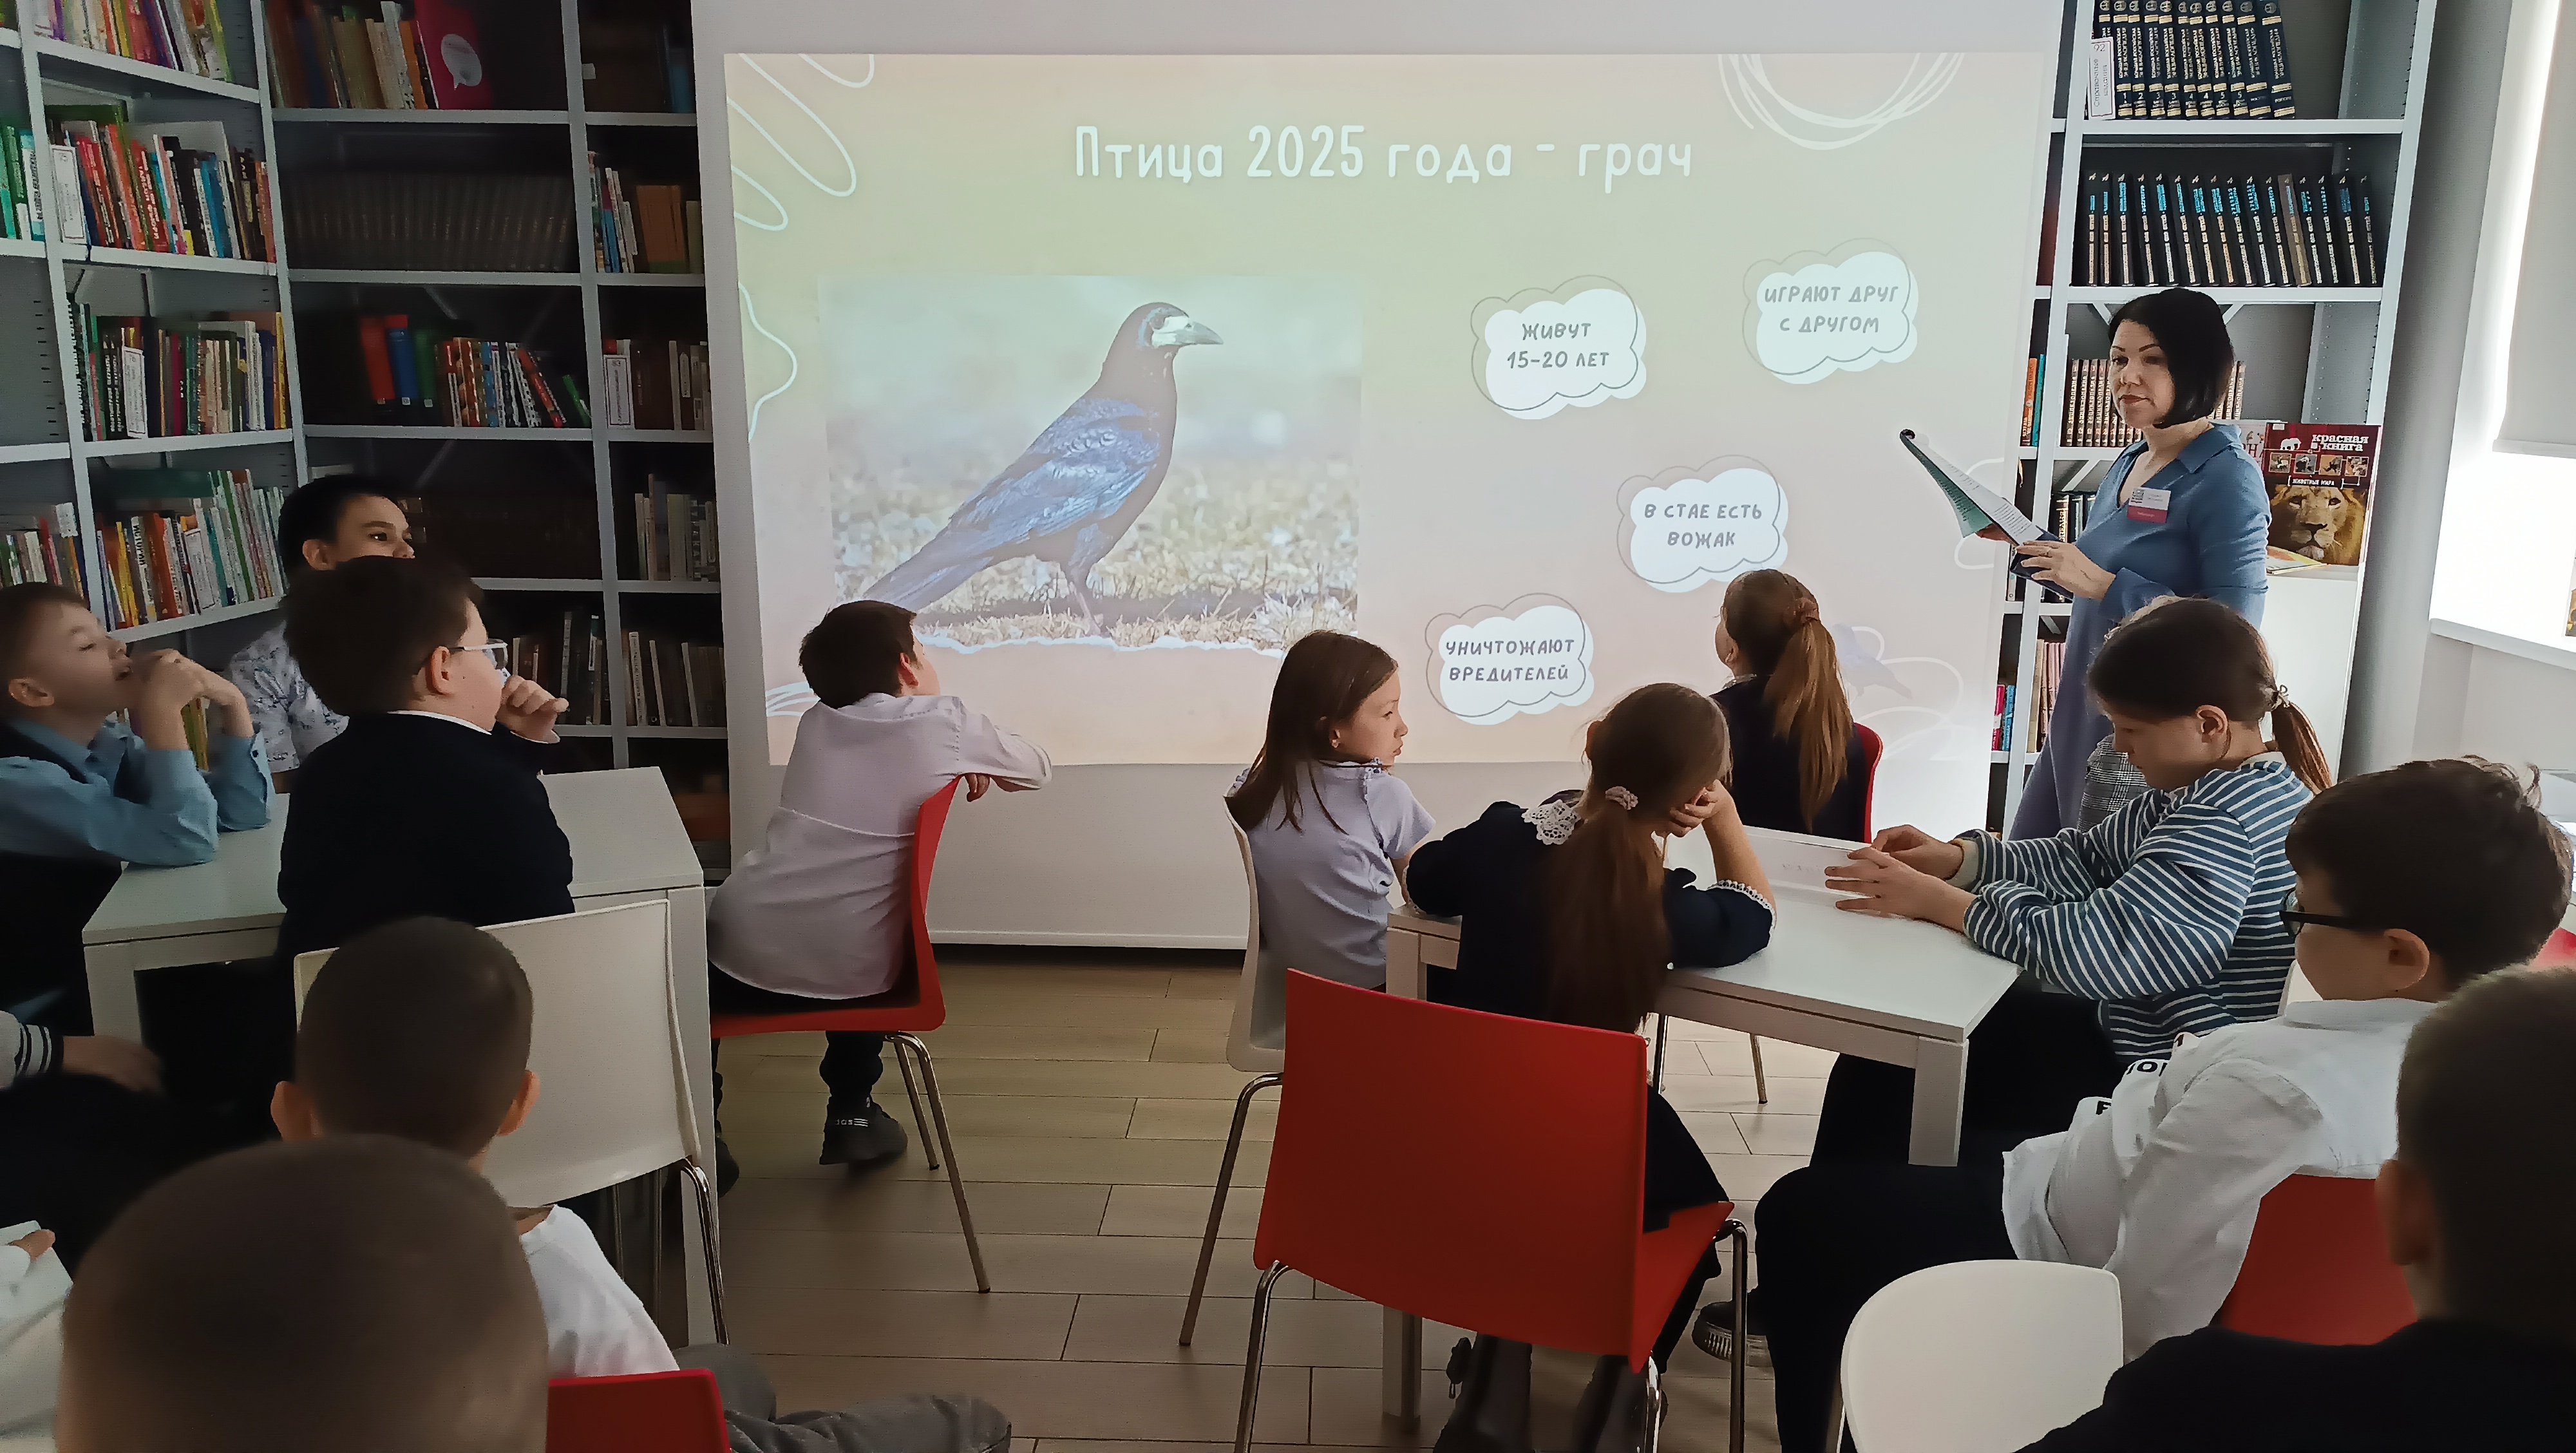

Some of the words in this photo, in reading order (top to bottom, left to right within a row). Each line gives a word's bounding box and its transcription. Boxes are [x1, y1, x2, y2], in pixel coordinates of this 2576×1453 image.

[2094, 44, 2105, 52] 92
[1075, 126, 1223, 183] Птица
[1247, 124, 1365, 177] 2025
[1388, 144, 1511, 184] года
[1578, 142, 1692, 193] грач
[1765, 285, 1841, 303] ИГРАЮТ
[1848, 285, 1899, 302] ДРУГ
[1522, 323, 1591, 341] ЖИВУТ
[1779, 318, 1790, 332] С
[1799, 316, 1879, 333] ДРУГОМ
[1507, 351, 1568, 369] 15-20
[1576, 352, 1609, 367] ЛЕТ
[2312, 435, 2369, 444] красная
[2322, 442, 2363, 451] книга
[1644, 504, 1656, 518] В
[1664, 504, 1709, 518] СТАЕ
[1717, 504, 1762, 519] ЕСТЬ
[1667, 531, 1736, 549] ВОЖАК
[1446, 639, 1574, 656] УНИЧТОЖАЮТ
[1450, 664, 1568, 682] ВРЕДИТЕЛЕЙ
